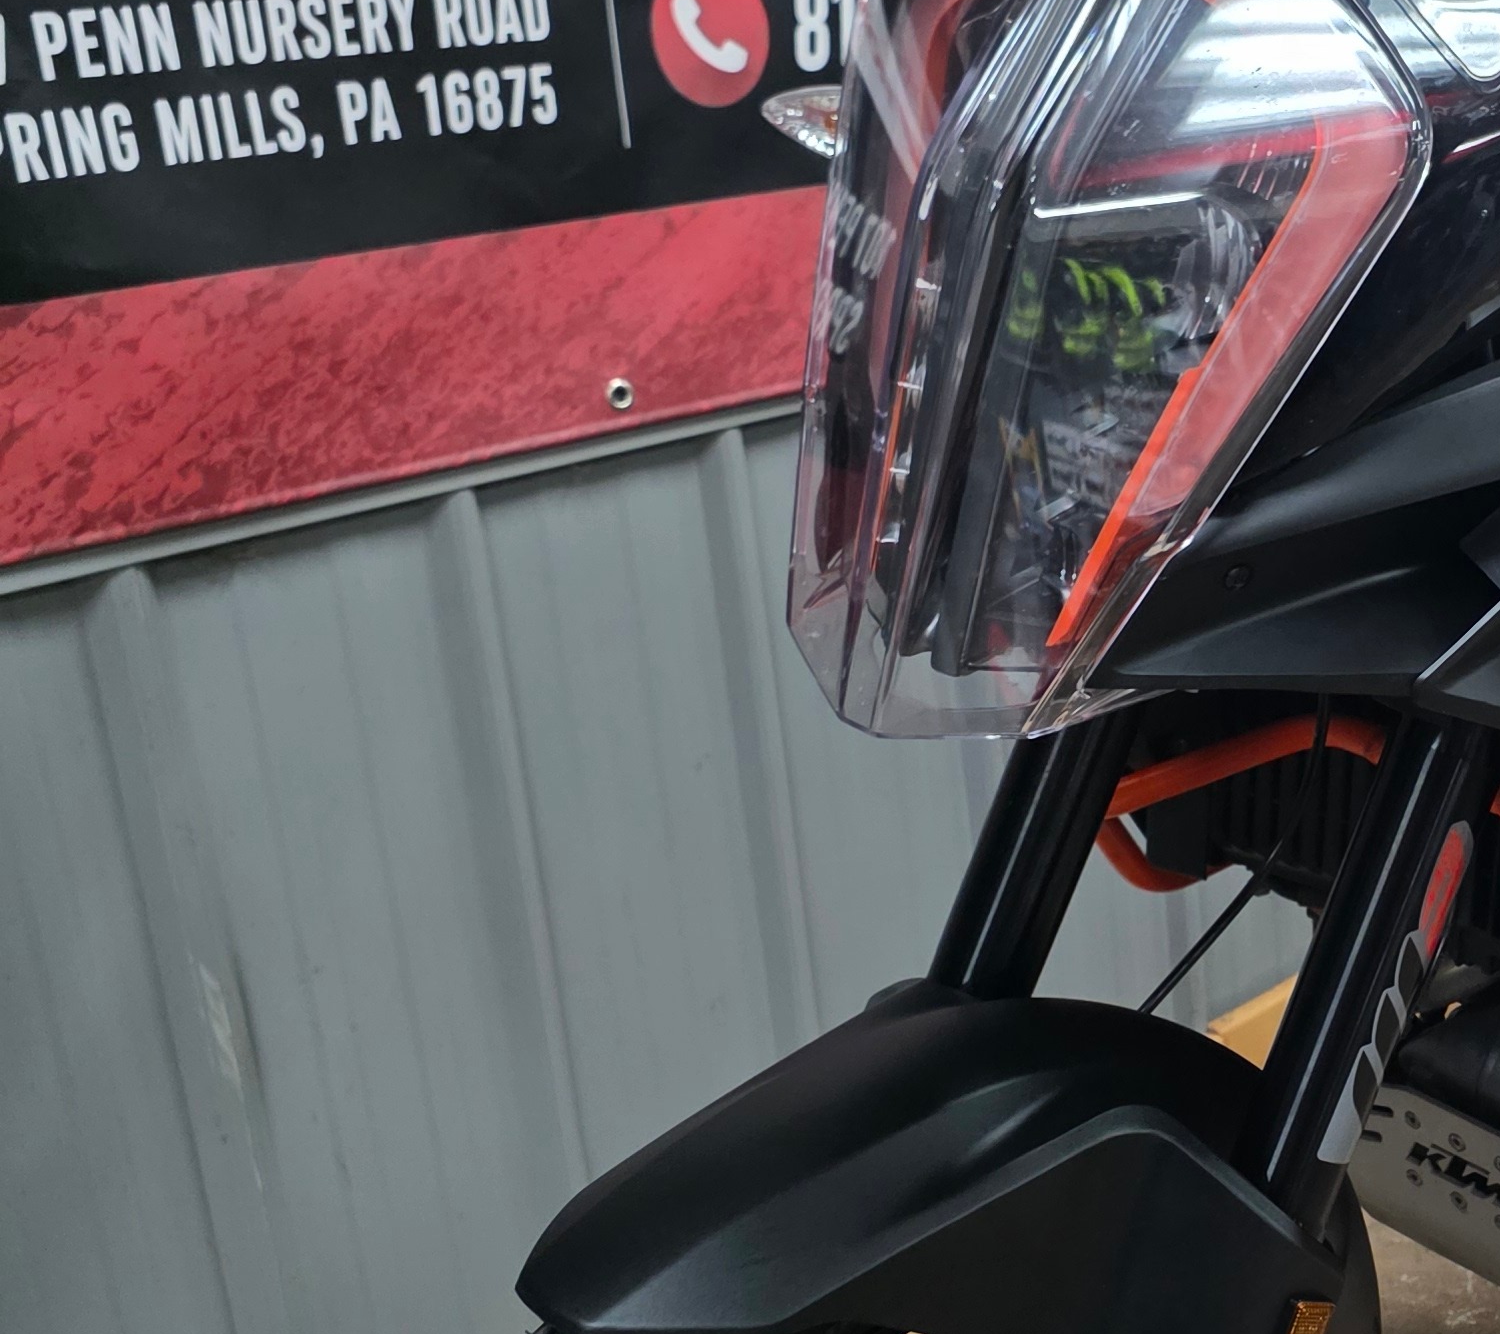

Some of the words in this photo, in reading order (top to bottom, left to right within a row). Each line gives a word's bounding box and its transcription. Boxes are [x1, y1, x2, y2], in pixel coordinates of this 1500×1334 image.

[30, 1, 182, 82] PENN
[0, 101, 141, 184] RING
[153, 85, 324, 167] MILLS,
[337, 76, 402, 147] PA
[416, 65, 558, 135] 16875
